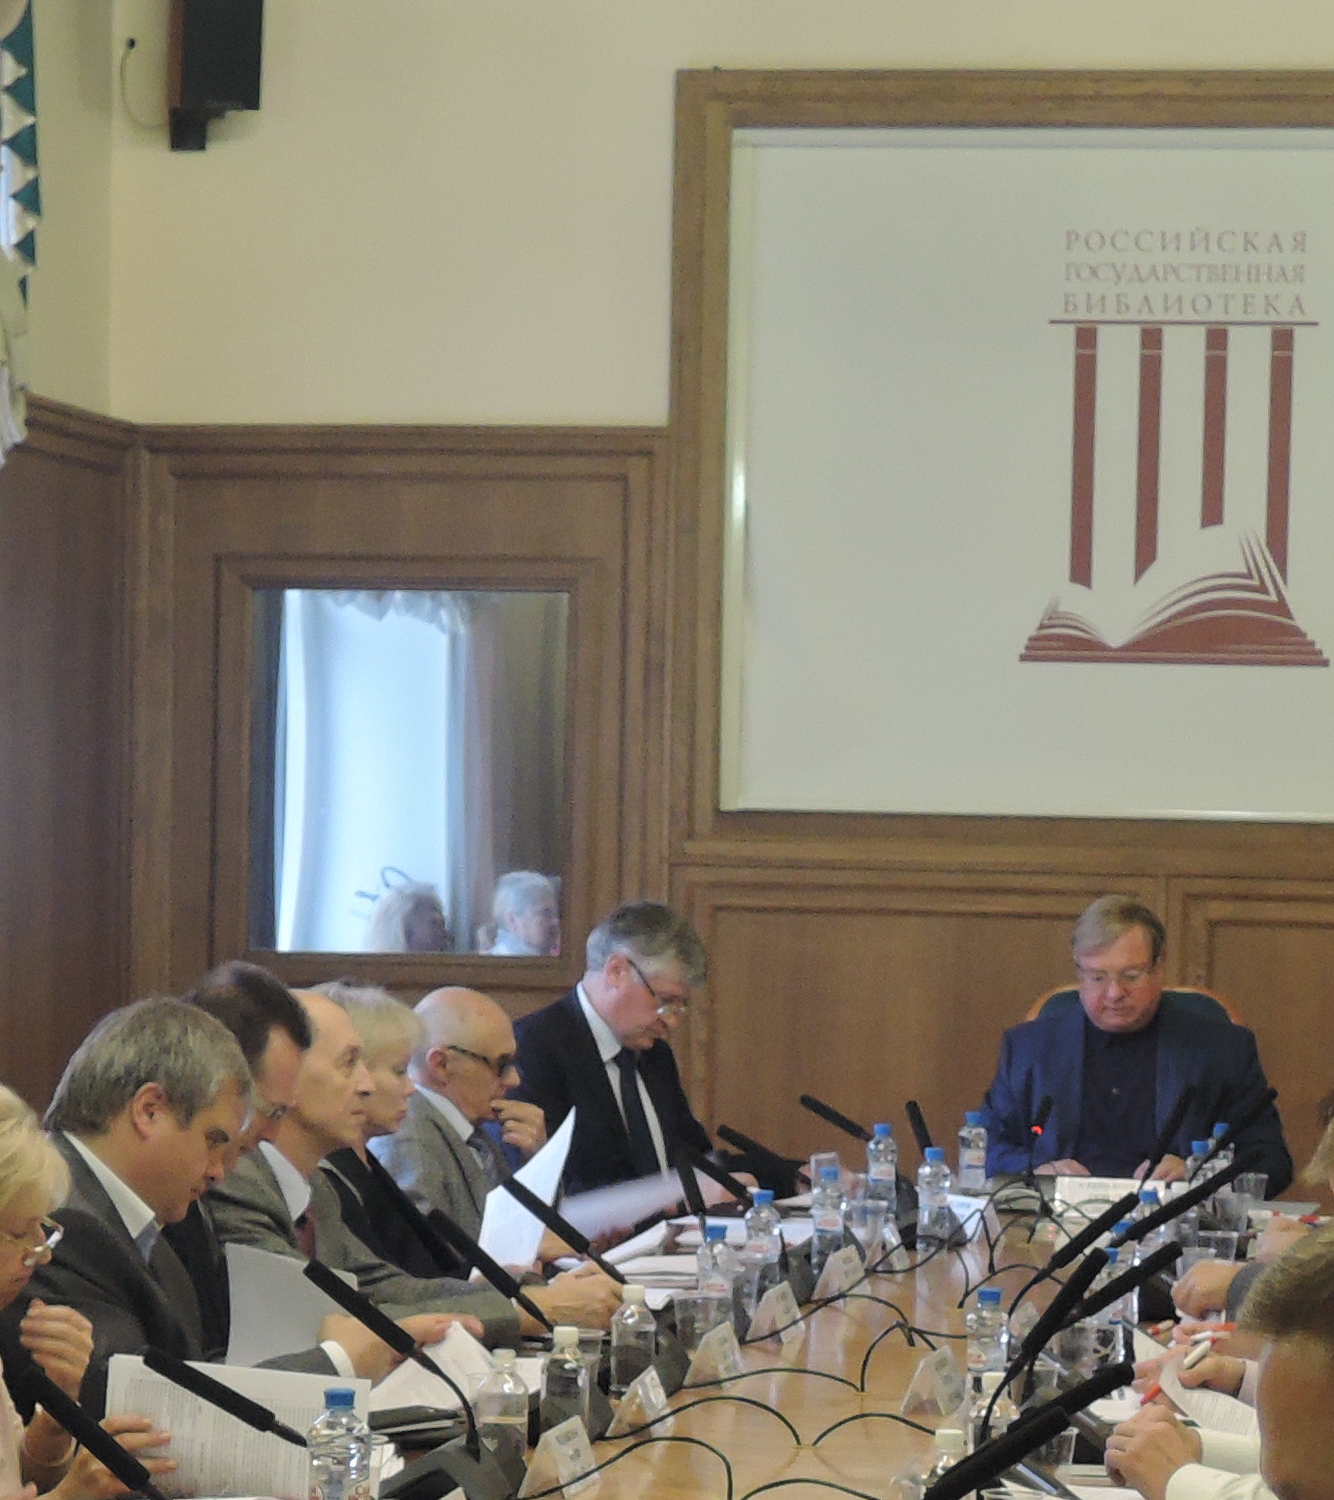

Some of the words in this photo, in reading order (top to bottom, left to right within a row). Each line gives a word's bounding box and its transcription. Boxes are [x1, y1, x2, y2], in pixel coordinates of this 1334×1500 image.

[1065, 226, 1307, 254] РОССИЙСКАЯ
[1064, 261, 1305, 285] ГОСУДАРСТВЕННАЯ
[1063, 292, 1307, 316] БИБЛИОТЕКА
